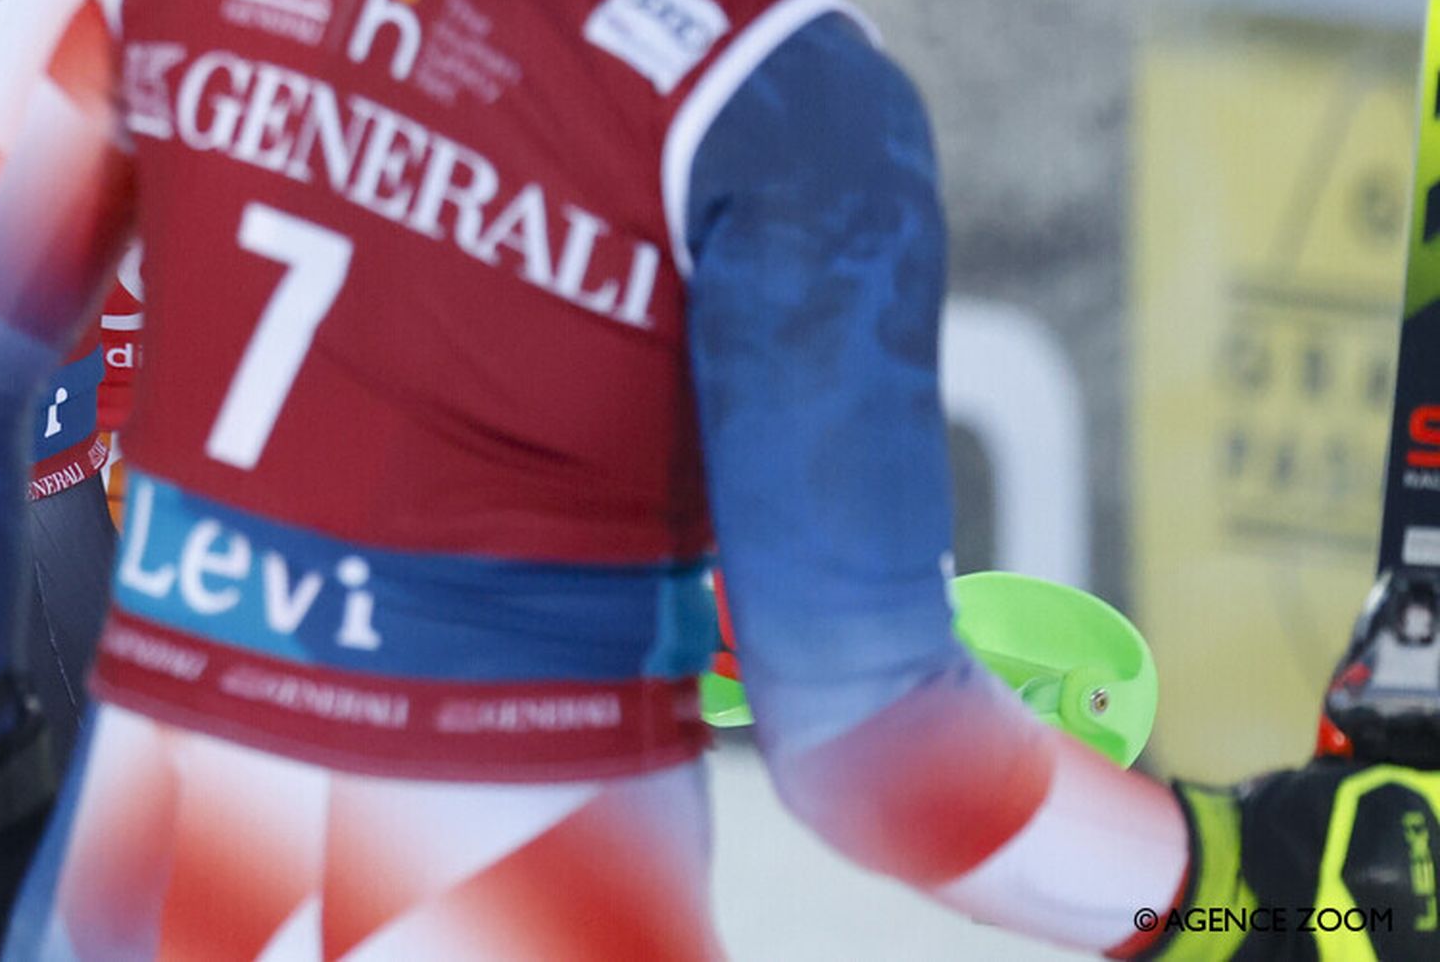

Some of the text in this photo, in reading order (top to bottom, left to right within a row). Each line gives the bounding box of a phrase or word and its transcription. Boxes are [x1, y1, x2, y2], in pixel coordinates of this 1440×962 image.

[176, 49, 659, 332] GENERALI
[205, 200, 354, 472] 7
[118, 481, 382, 651] Levi
